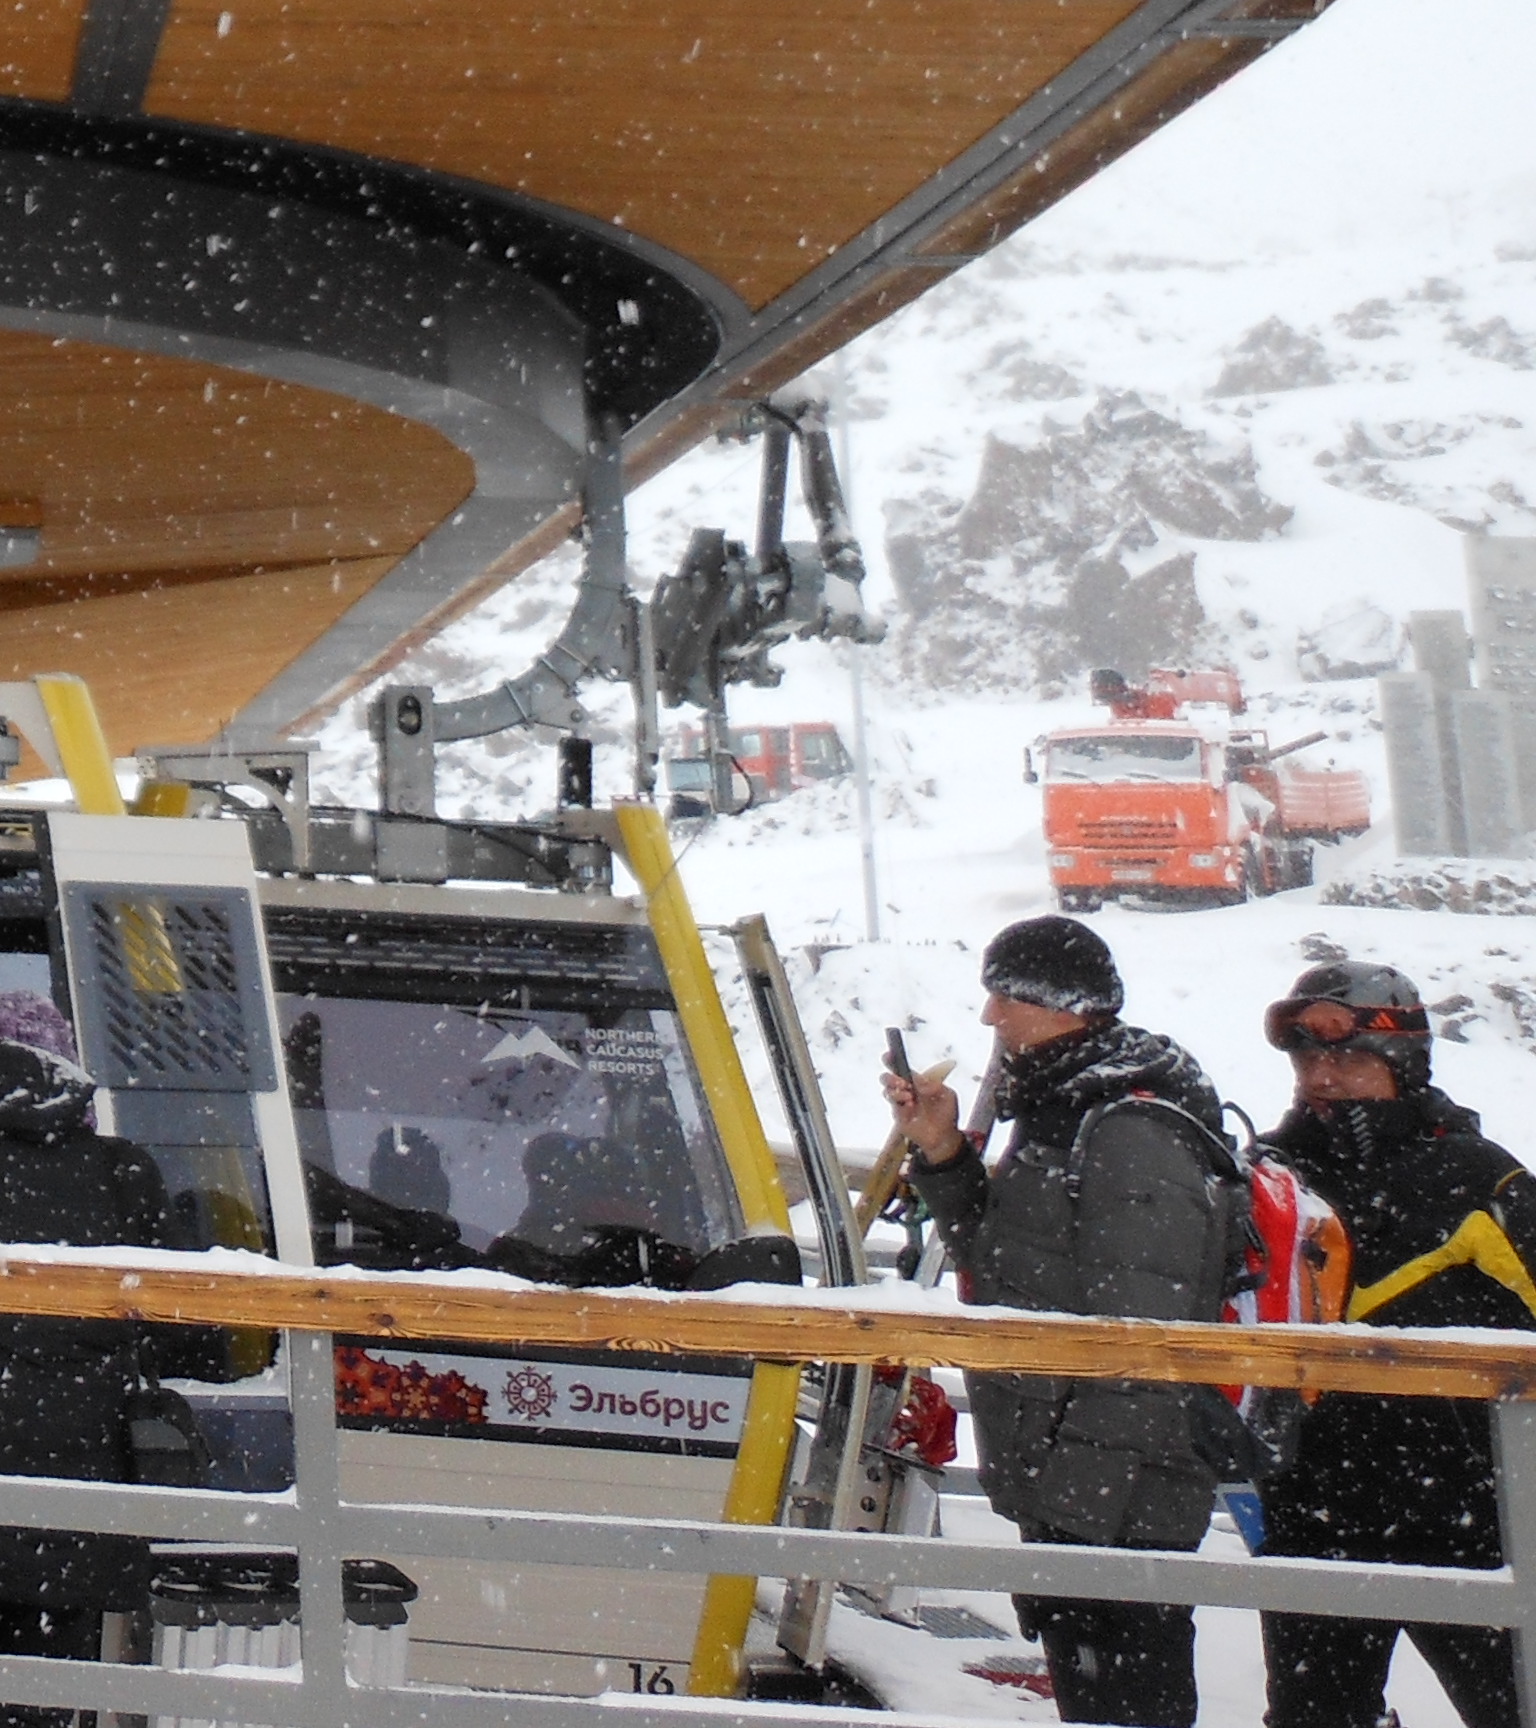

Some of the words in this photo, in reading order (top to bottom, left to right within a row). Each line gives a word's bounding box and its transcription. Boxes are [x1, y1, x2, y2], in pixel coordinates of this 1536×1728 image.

[586, 1044, 664, 1060] CAUCASUS
[588, 1060, 655, 1075] RESORTS
[568, 1383, 730, 1430] Эльбрус
[628, 1662, 675, 1694] 16
